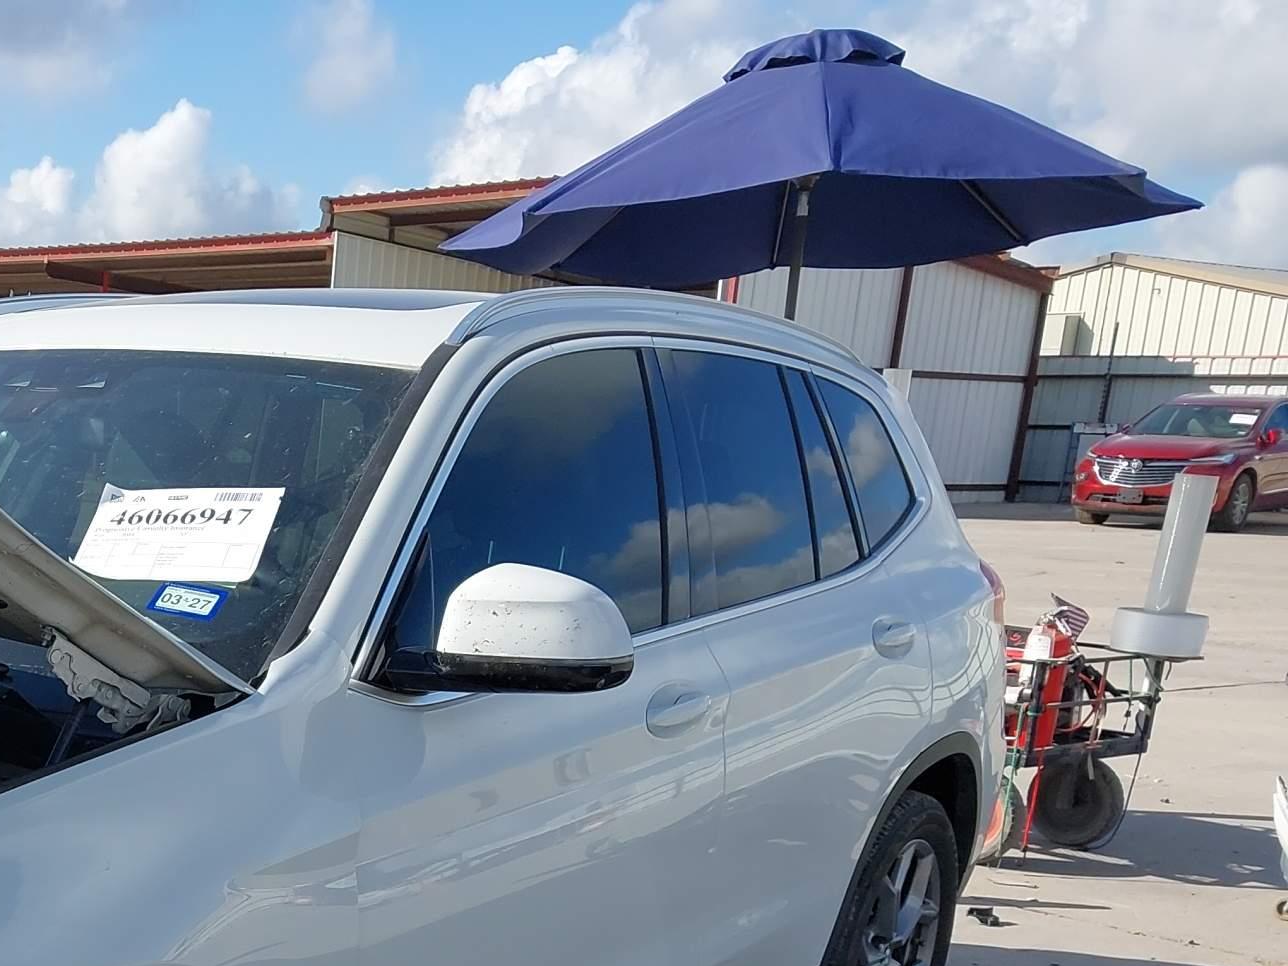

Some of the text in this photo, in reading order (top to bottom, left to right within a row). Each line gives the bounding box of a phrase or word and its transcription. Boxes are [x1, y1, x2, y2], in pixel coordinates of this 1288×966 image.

[110, 508, 255, 525] 46066947
[160, 592, 183, 606] 03
[187, 597, 213, 610] 27
